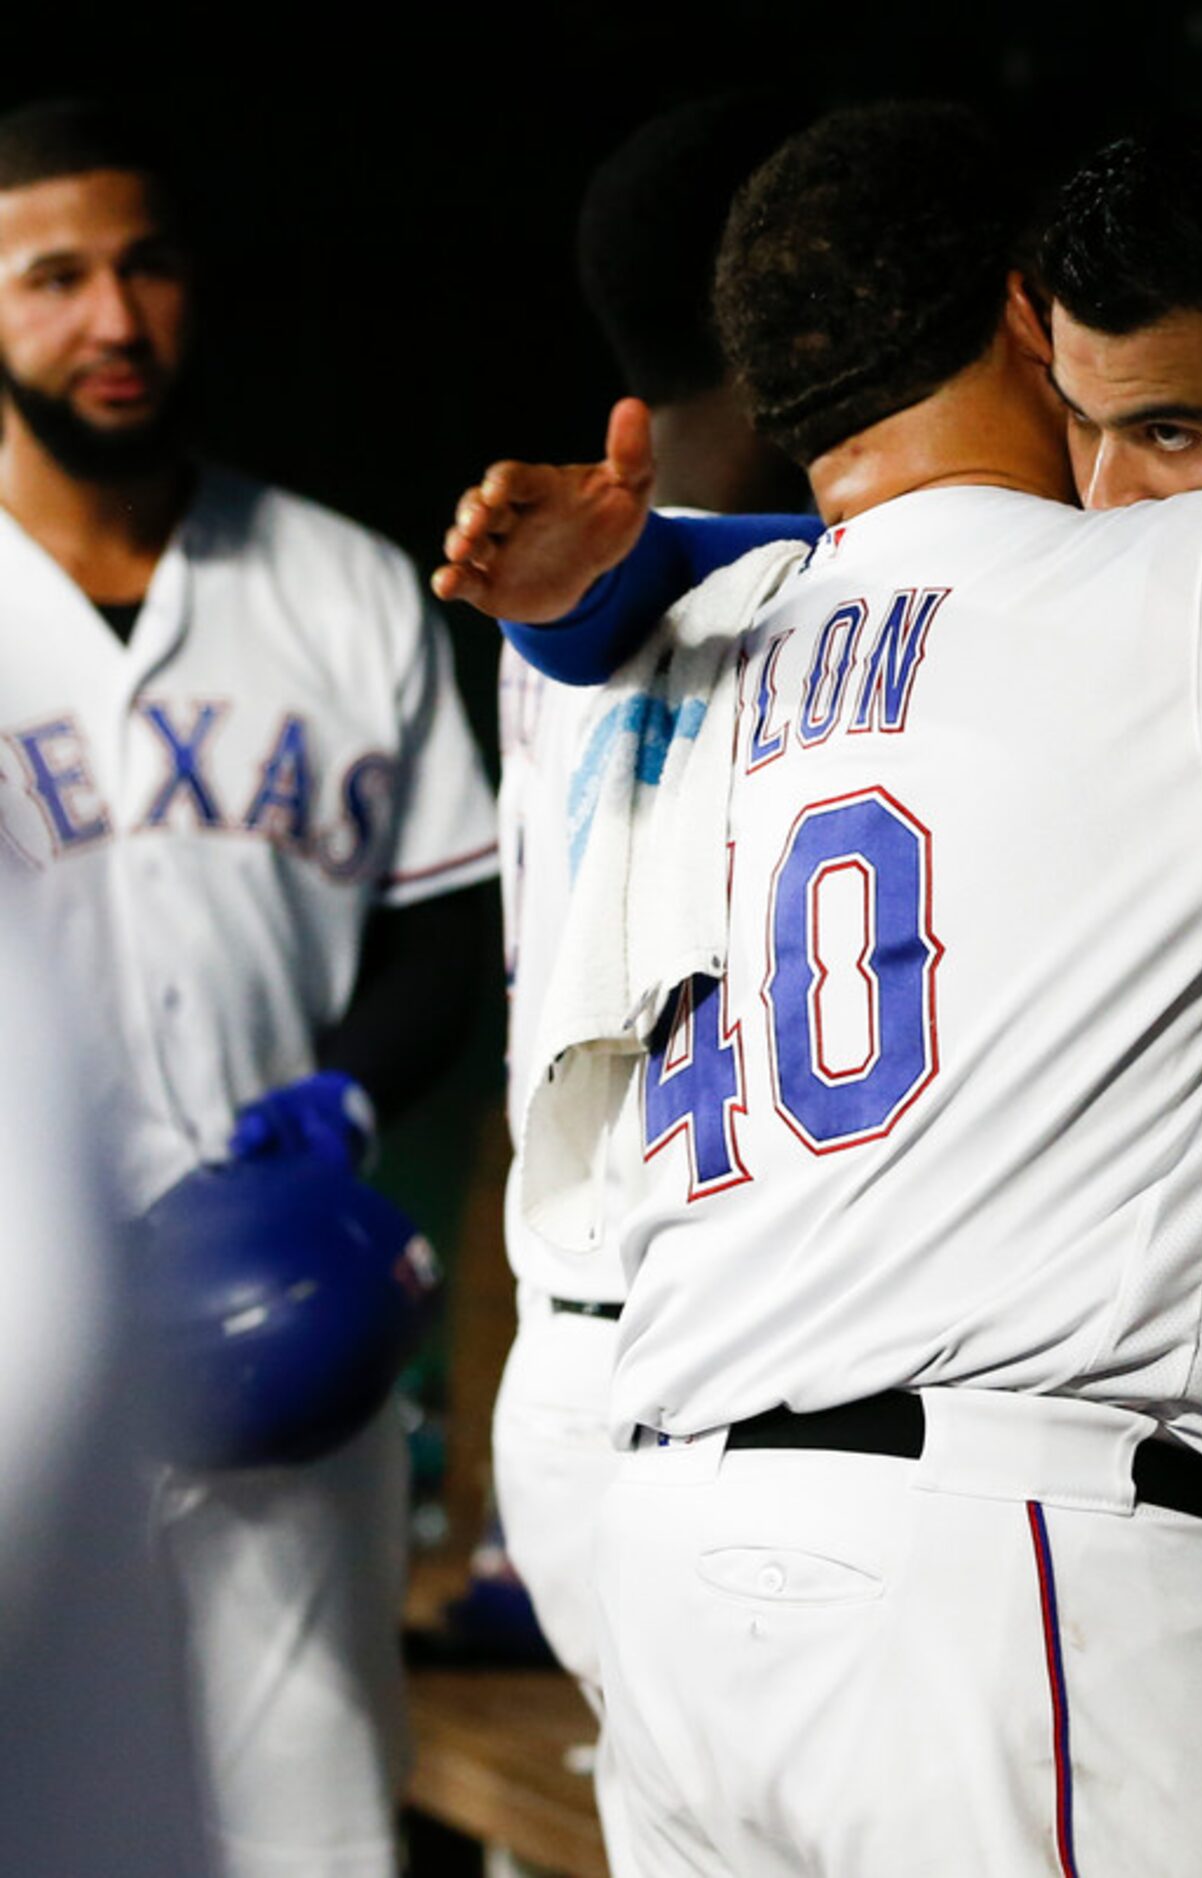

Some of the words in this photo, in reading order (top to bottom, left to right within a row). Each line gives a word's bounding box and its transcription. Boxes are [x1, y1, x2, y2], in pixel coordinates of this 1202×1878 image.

[738, 586, 952, 775] LON
[0, 698, 398, 884] EXAS
[643, 784, 947, 1204] 40
